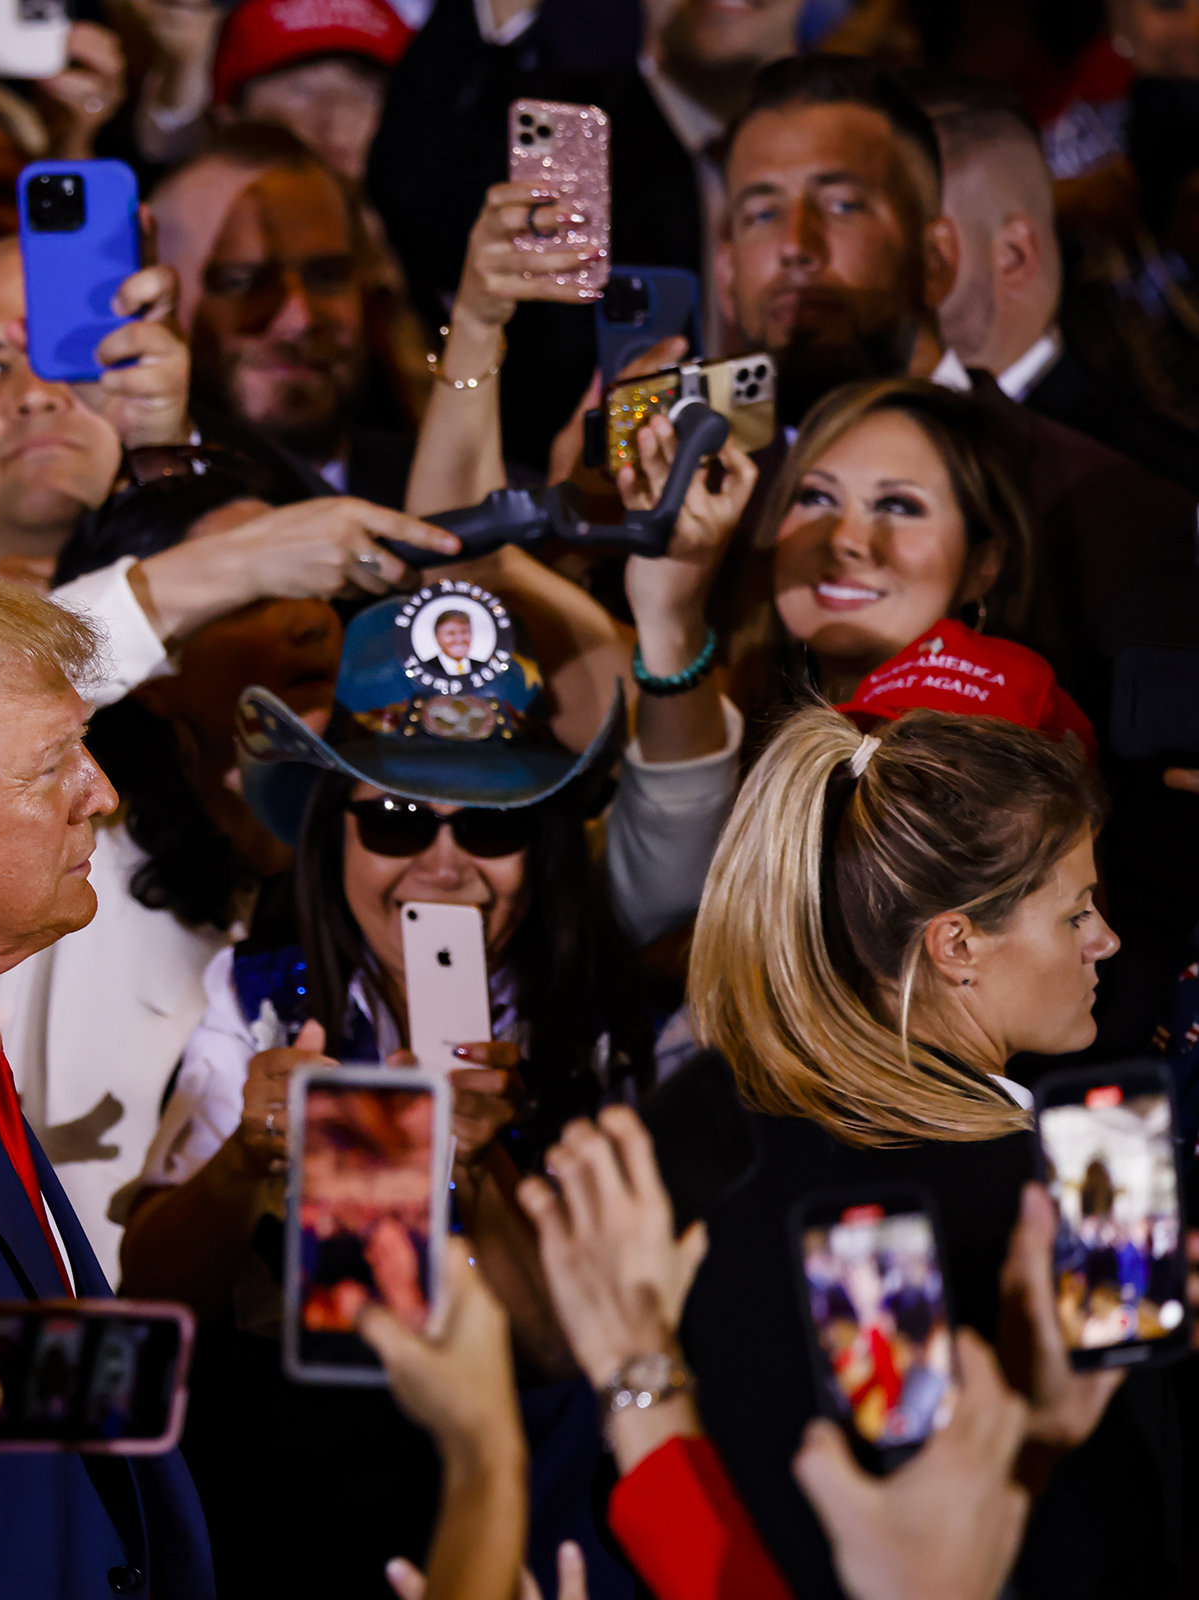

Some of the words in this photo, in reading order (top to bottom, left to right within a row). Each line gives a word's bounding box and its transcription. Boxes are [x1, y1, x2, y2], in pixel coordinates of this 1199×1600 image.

[394, 586, 434, 629] Save
[440, 578, 511, 629] America
[403, 654, 463, 695] Trump
[469, 648, 511, 688] 2024
[917, 653, 1006, 687] AMERICA
[919, 674, 991, 702] AGAIN
